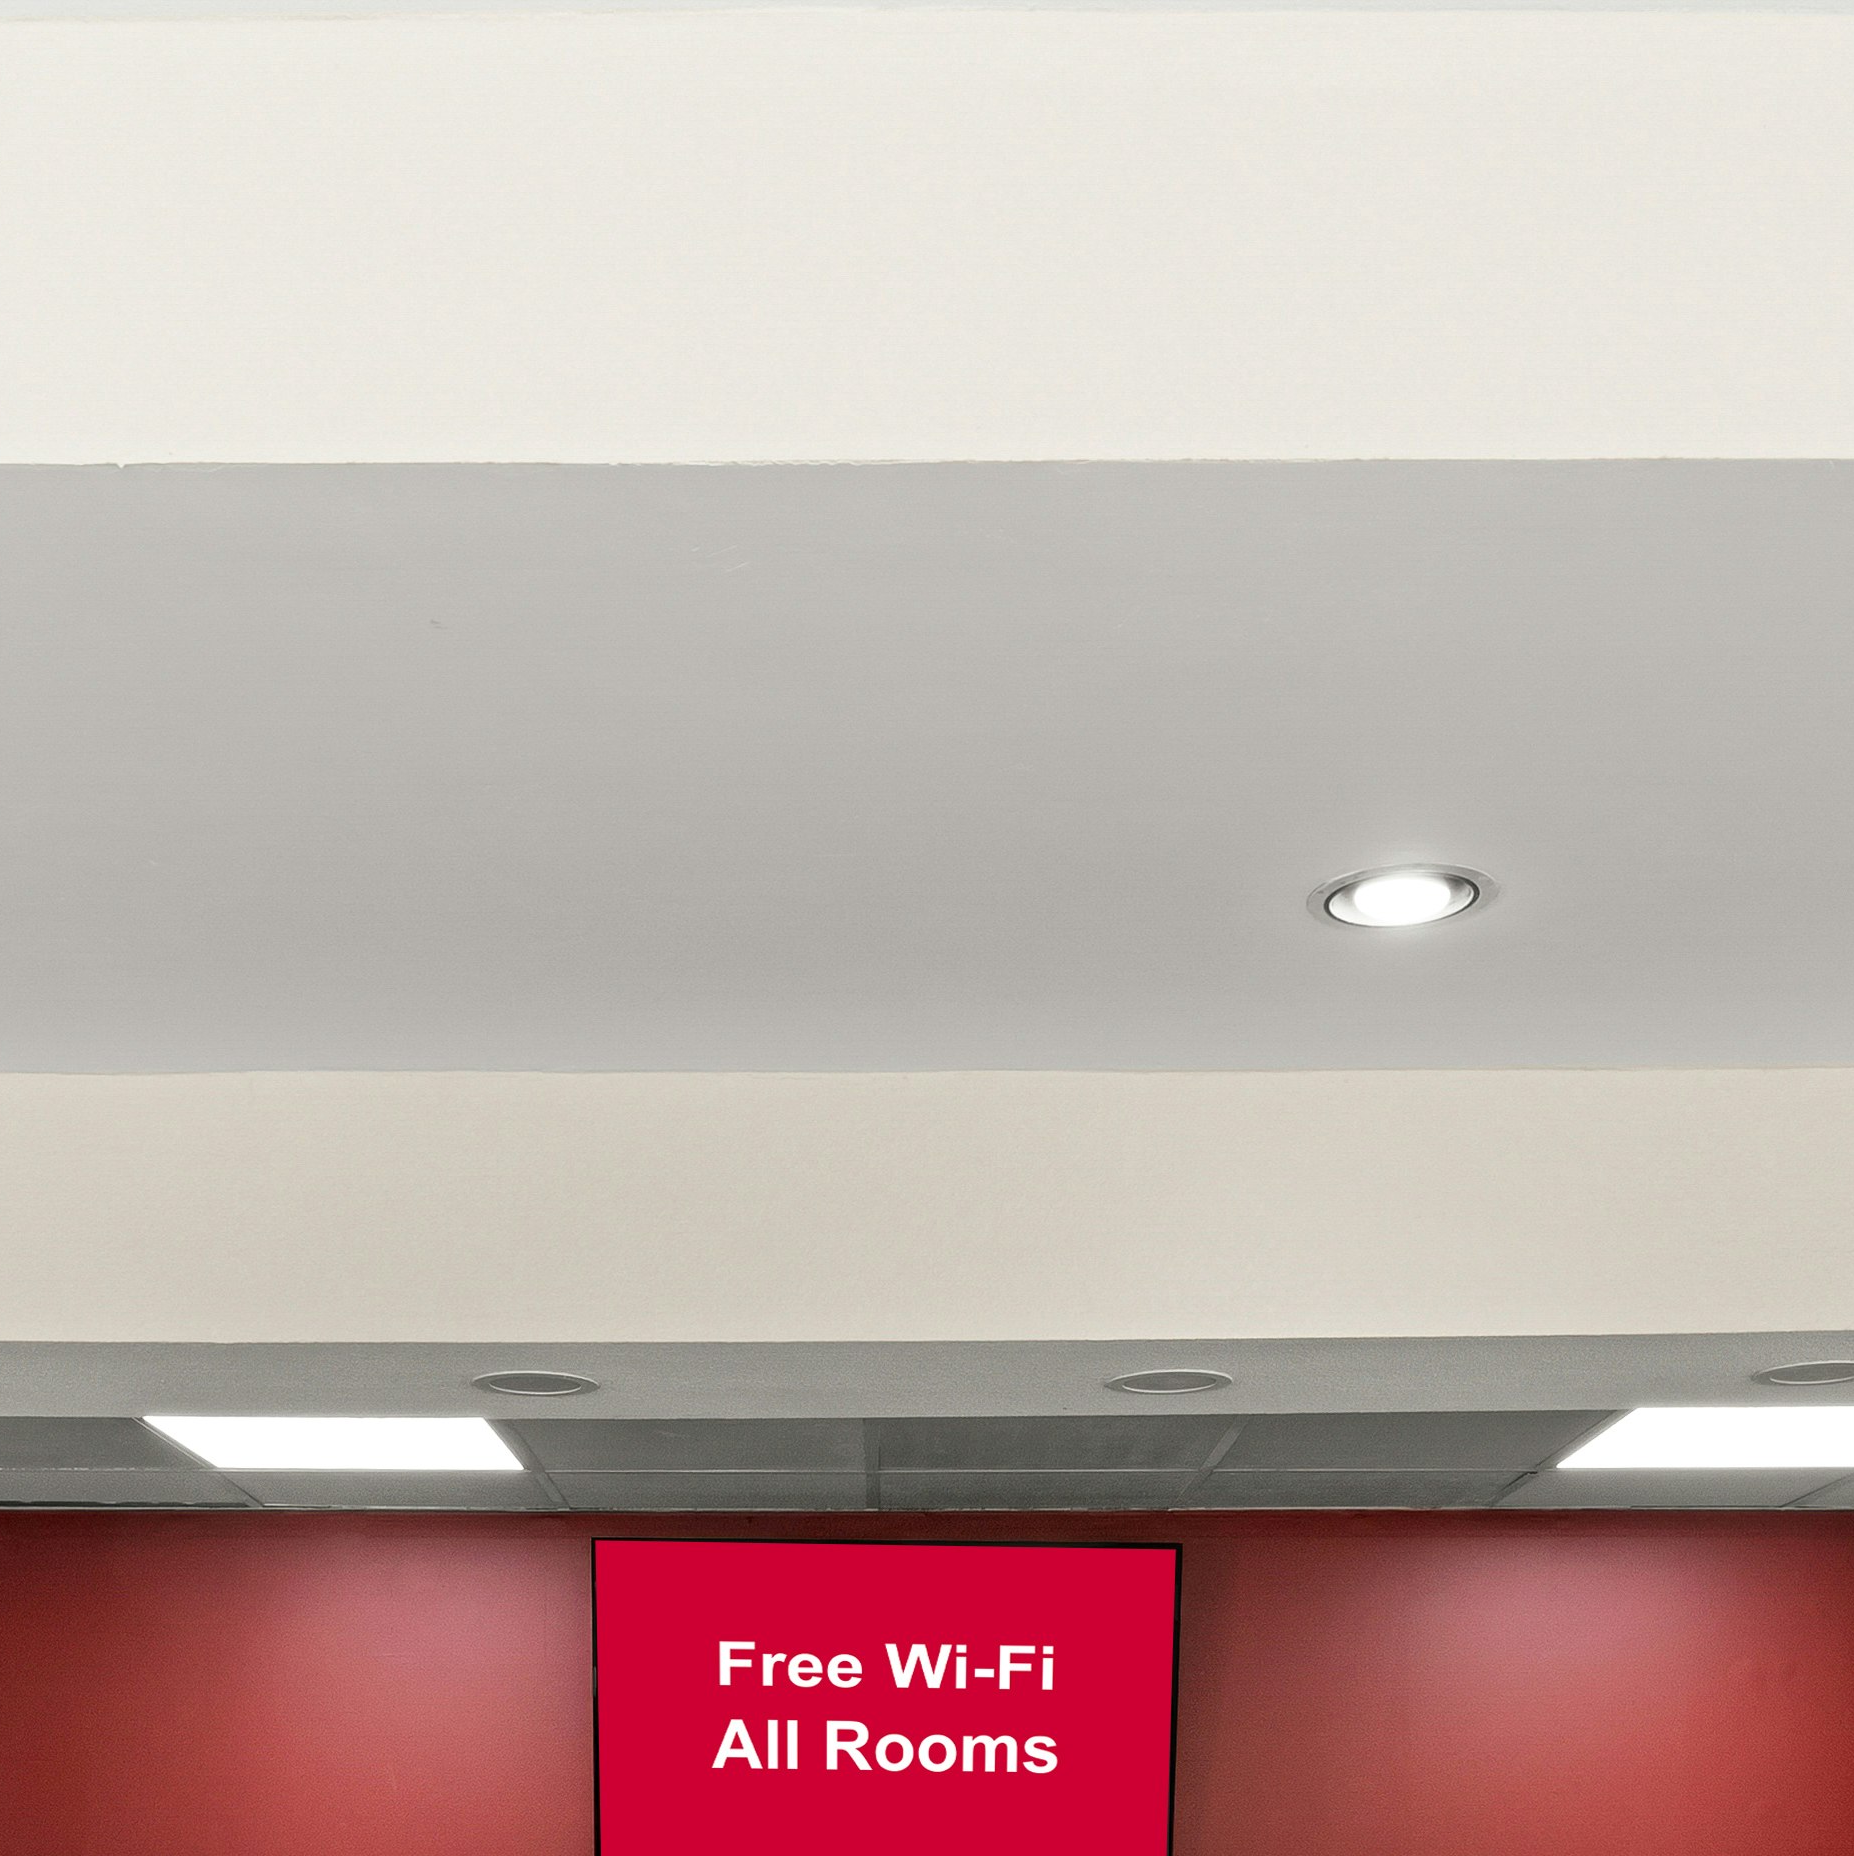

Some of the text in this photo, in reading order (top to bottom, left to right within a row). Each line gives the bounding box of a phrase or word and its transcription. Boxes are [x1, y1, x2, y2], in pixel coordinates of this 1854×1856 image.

[718, 1640, 1055, 1691] Free Wi-Fi
[711, 1718, 1059, 1774] All Rooms
